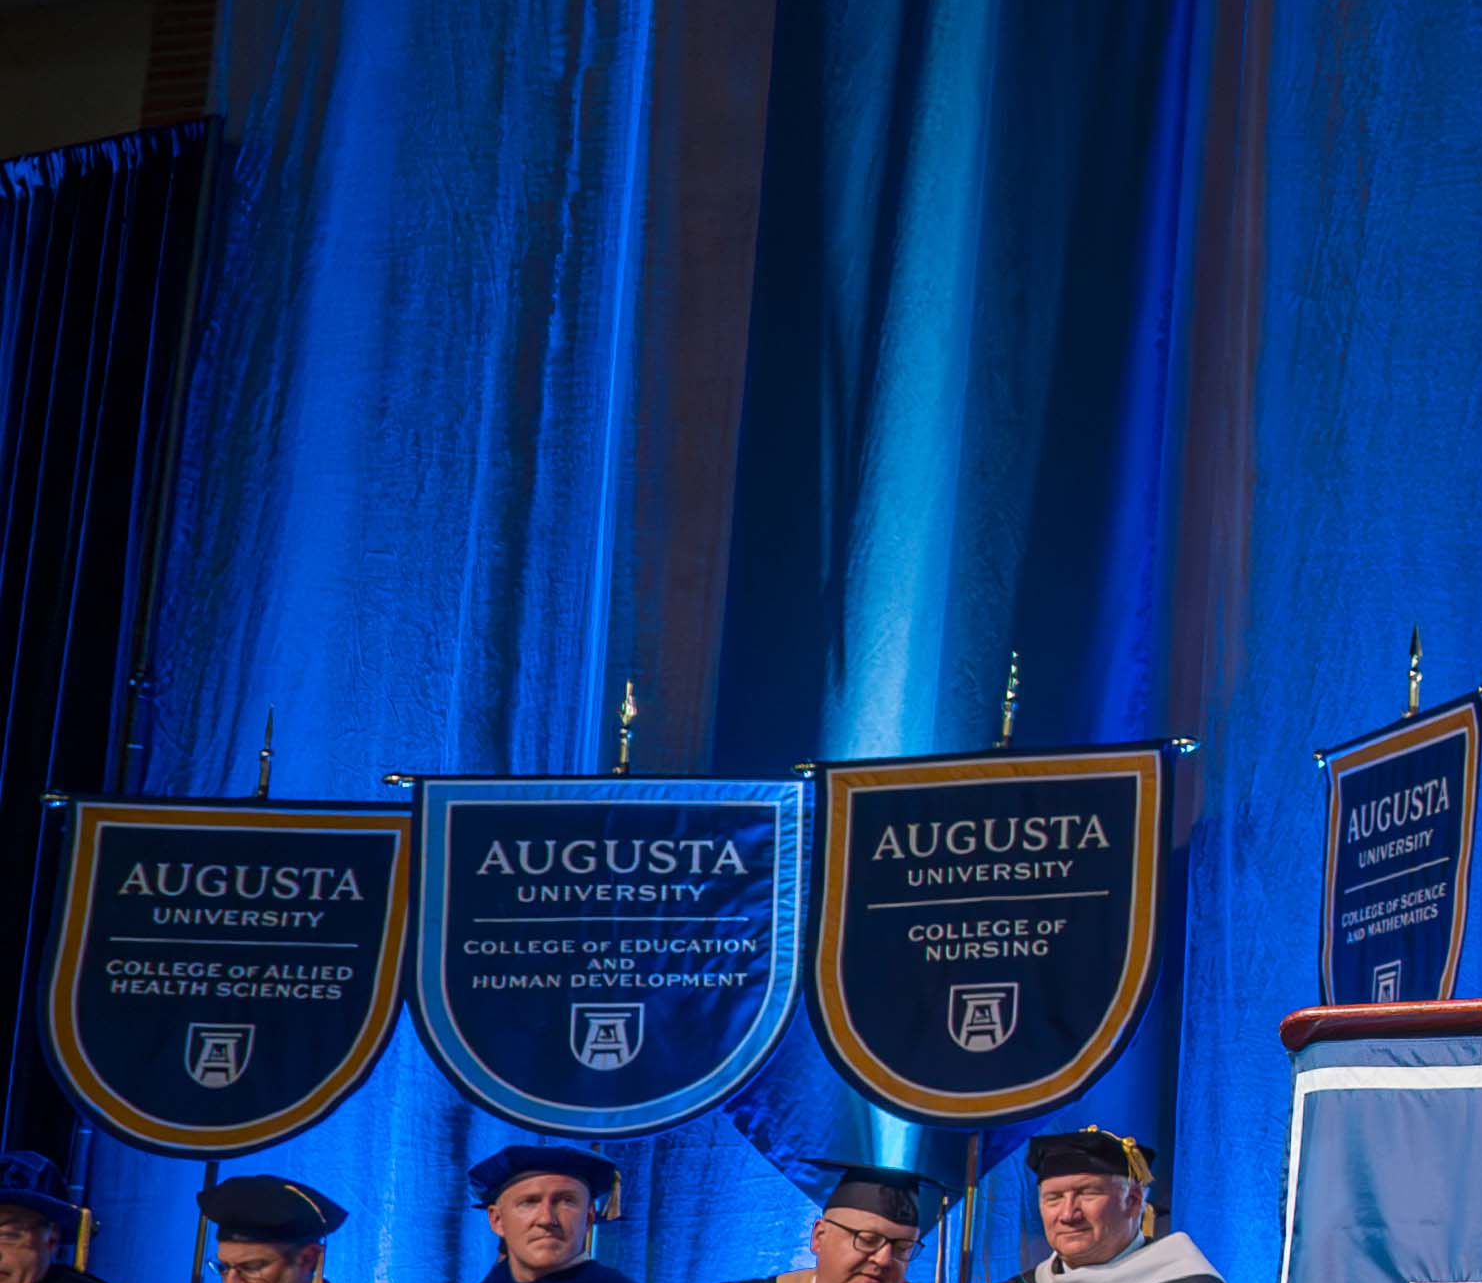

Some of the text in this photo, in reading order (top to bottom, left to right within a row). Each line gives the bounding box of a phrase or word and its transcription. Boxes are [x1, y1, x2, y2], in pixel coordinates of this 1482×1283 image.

[1347, 776, 1450, 844] AUGUSTA
[872, 815, 1110, 861] AUGUSTA
[1358, 829, 1434, 869] UNIVERSITY
[476, 839, 749, 875] AUGUSTA
[118, 862, 364, 900] AUGUSTA
[907, 860, 1073, 887] UNIVERSITY
[517, 884, 706, 903] UNIVERSITY
[1341, 899, 1386, 928] COLLEGE
[1400, 882, 1448, 910] SCIENCE
[153, 907, 324, 928] UNIVERSITY
[1346, 903, 1438, 944] AND MATHEMATICS
[908, 919, 1067, 942] COLLEGE OF
[463, 939, 575, 955] COLLEGE
[620, 939, 757, 954] EDUCATION
[926, 940, 1049, 962] NURSING
[106, 959, 222, 978] COLLEGE
[263, 965, 353, 981] ALLIED
[587, 958, 636, 971] AND
[111, 979, 342, 1000] HEALTH SCIENCES
[472, 972, 748, 989] HUMAN DEVELOPMENT
